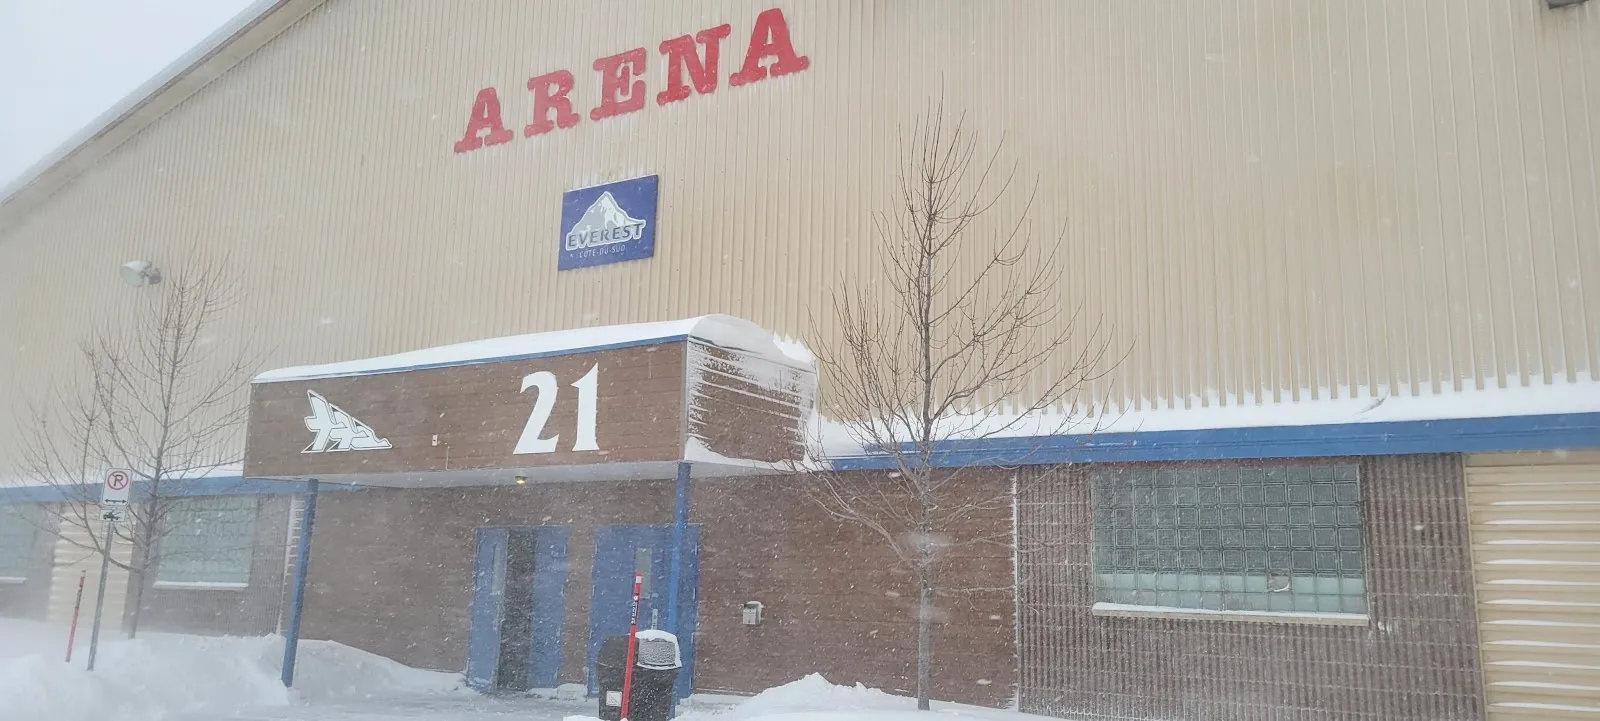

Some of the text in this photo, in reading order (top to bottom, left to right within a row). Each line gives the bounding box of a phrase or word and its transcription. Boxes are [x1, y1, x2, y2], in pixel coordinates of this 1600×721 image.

[454, 7, 809, 153] ARENA
[568, 223, 643, 247] EVEREST
[512, 362, 600, 454] 21
